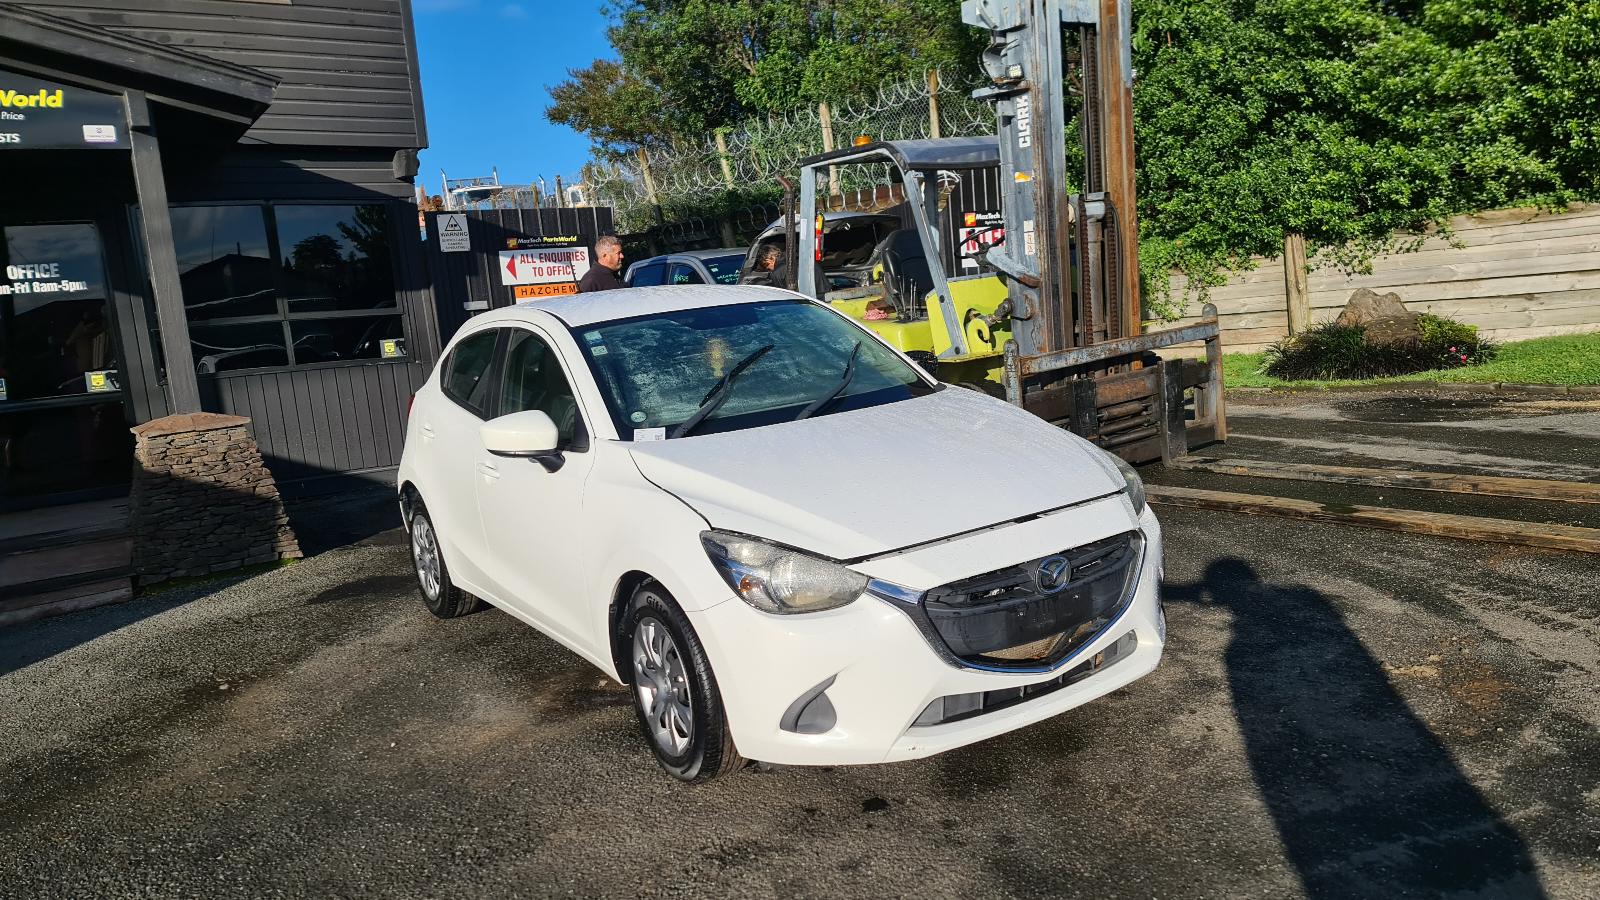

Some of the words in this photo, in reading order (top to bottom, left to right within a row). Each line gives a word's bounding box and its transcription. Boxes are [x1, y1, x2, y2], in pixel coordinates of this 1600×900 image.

[1, 111, 24, 120] Price
[1016, 94, 1031, 148] CLARK
[976, 211, 1000, 220] MaxTech
[517, 236, 541, 244] MaxTech
[543, 235, 577, 243] PartsWorld
[520, 253, 536, 264] ALL
[539, 250, 586, 263] ENQUIRIES
[6, 263, 60, 280] OFFICE
[532, 266, 544, 277] TO
[546, 264, 576, 276] OFFICE
[32, 280, 88, 292] 8am-5pm
[521, 285, 576, 295] HAZCHEM
